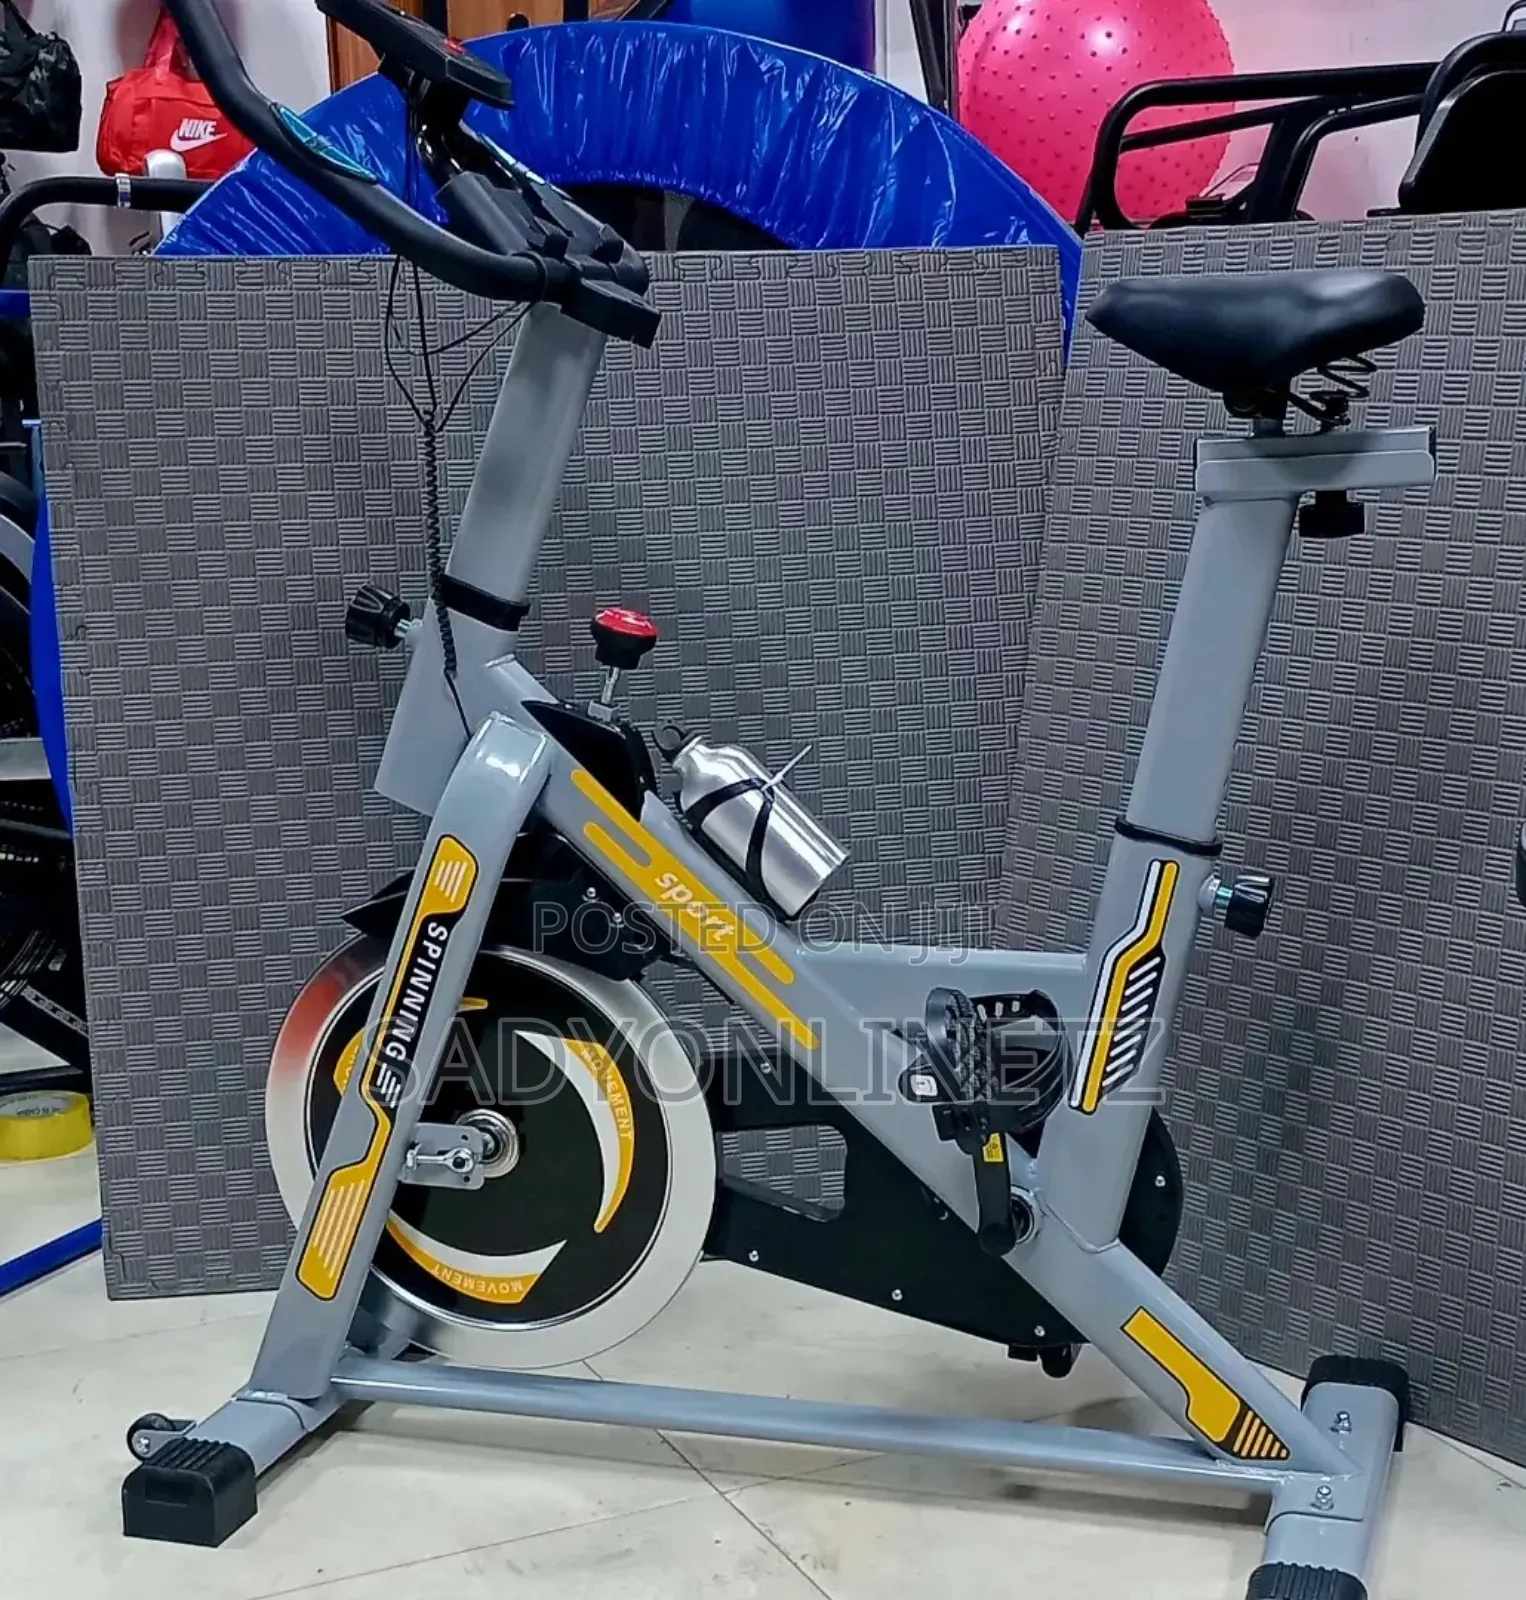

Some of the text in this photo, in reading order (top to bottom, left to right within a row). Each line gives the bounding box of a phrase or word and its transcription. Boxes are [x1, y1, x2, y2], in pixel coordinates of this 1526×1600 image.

[179, 118, 217, 138] NIKE
[654, 872, 735, 941] sport
[384, 921, 448, 1062] SPINNING
[581, 1044, 634, 1140] MOVEMENT
[432, 1263, 524, 1294] MOVEMENT
